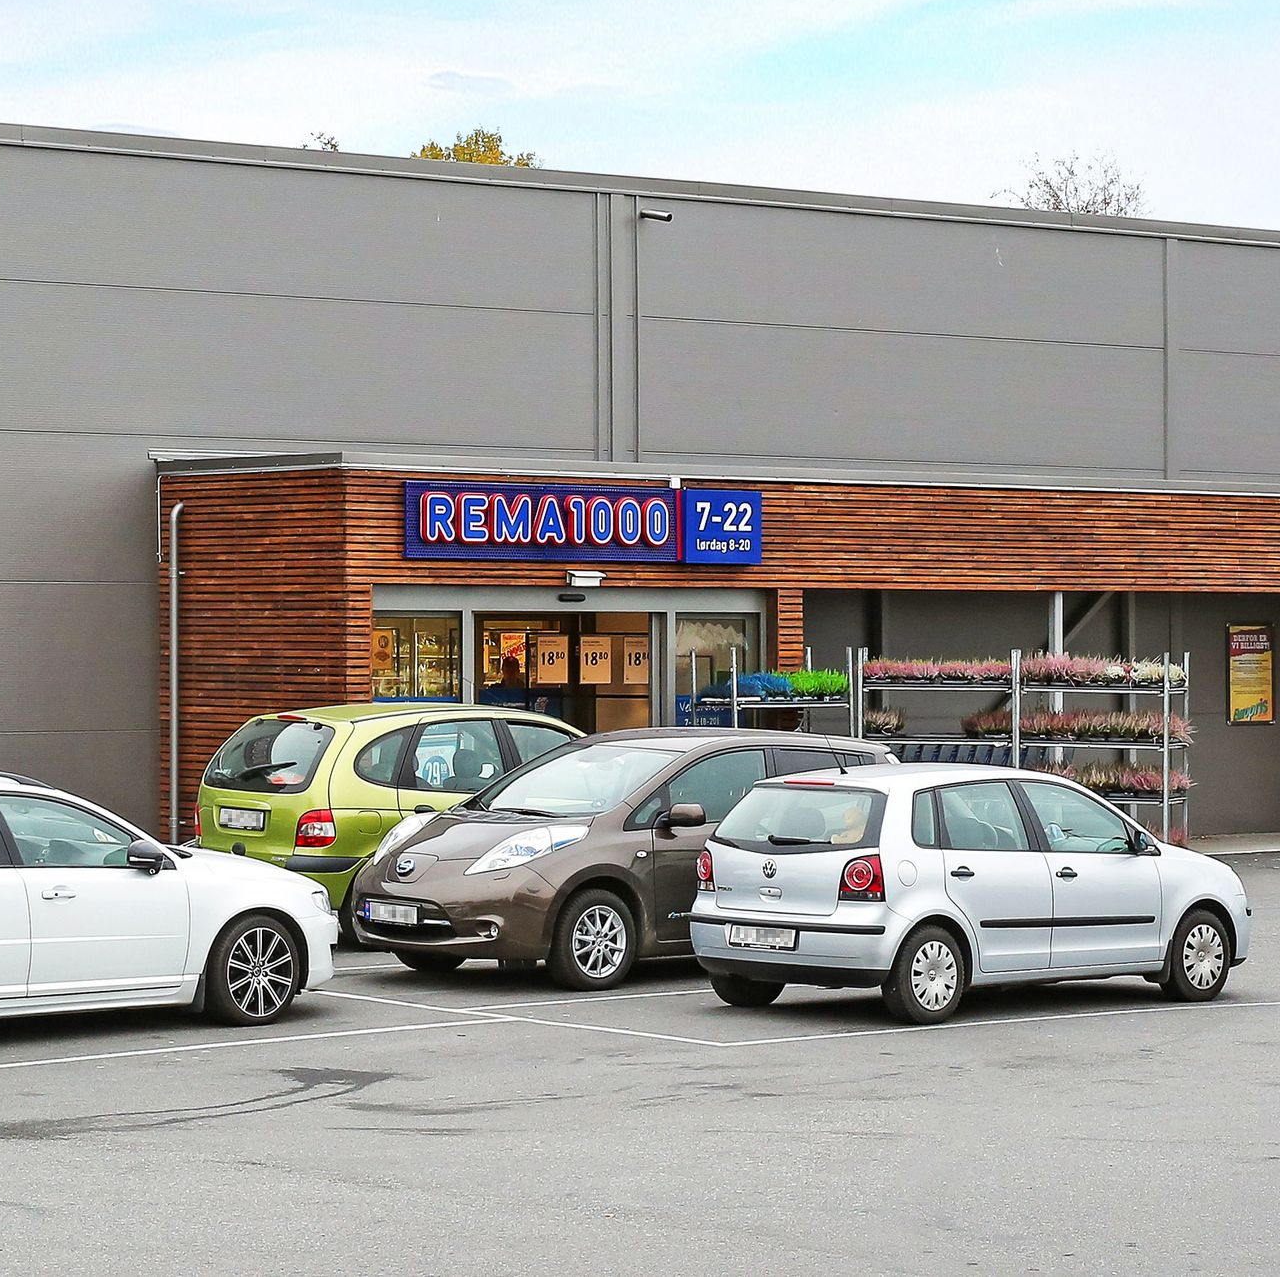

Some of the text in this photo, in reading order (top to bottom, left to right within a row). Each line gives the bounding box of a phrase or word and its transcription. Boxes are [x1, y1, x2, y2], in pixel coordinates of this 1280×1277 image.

[421, 492, 669, 547] REMA 1000
[696, 501, 753, 532] 7-22
[697, 539, 751, 553] lørdag 8-20
[1232, 642, 1239, 650] VI
